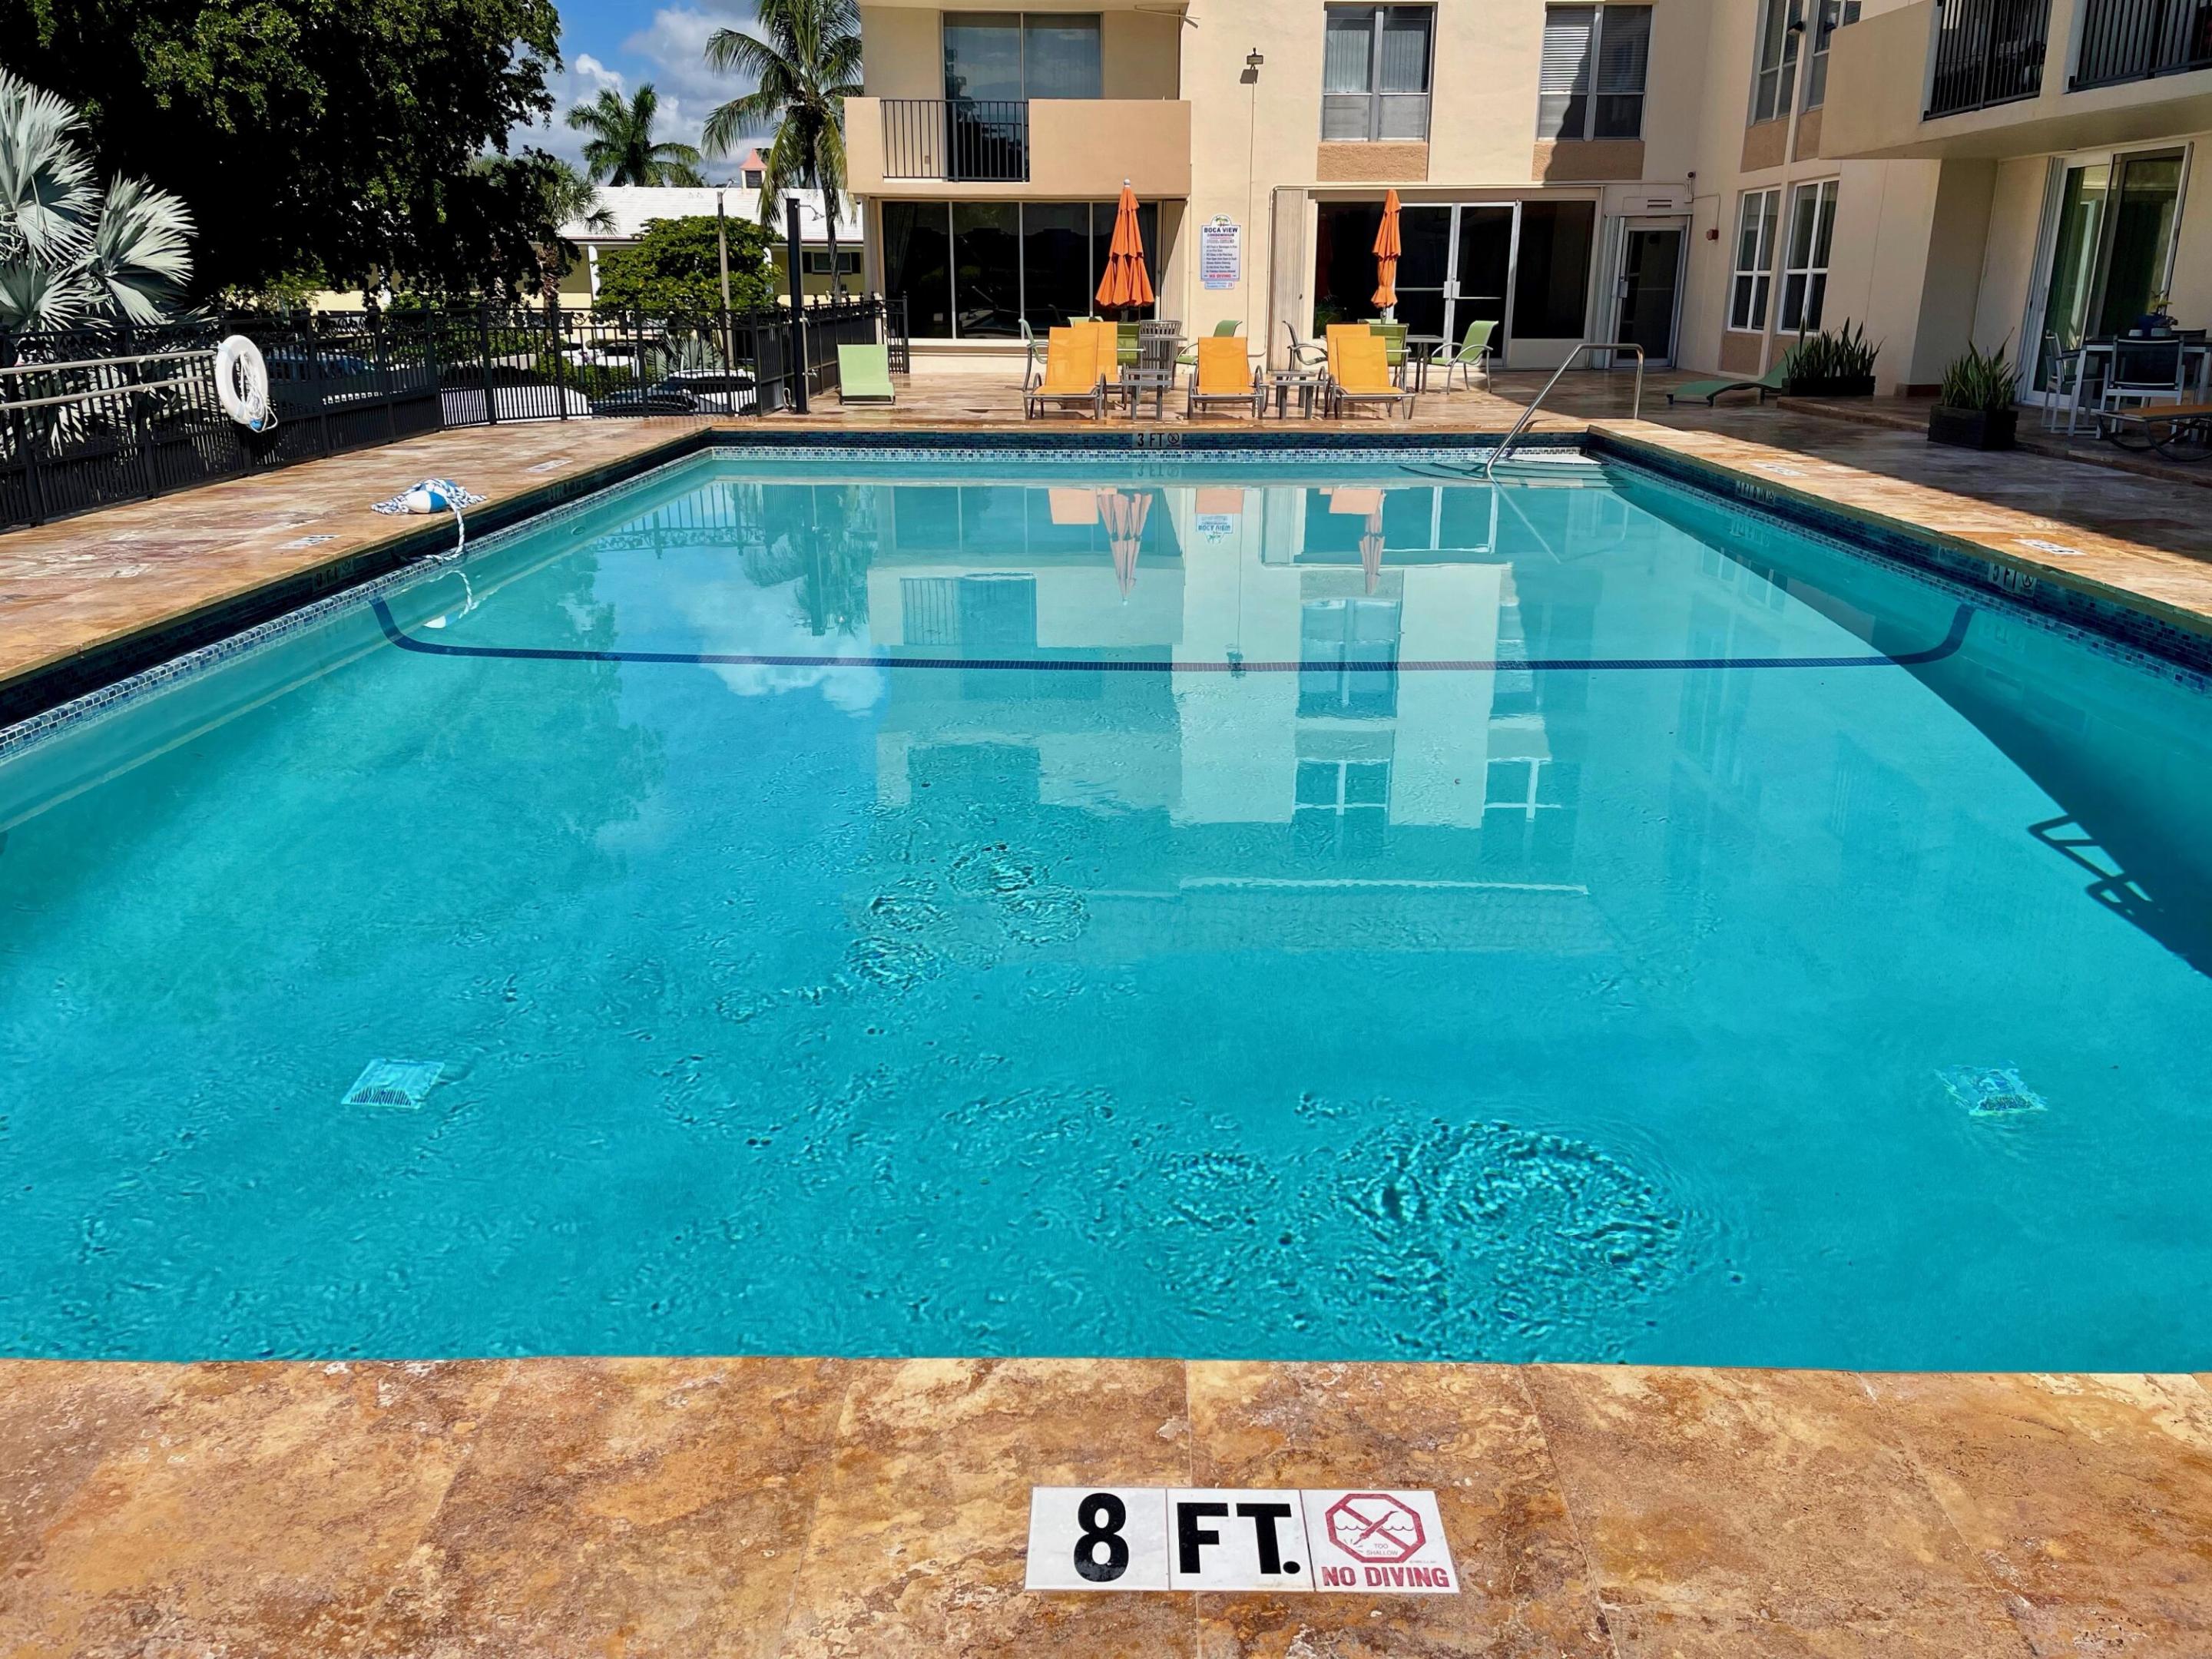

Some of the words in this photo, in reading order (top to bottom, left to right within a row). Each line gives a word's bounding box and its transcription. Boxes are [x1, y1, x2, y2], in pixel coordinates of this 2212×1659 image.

[1137, 433, 1144, 447] 3
[1150, 433, 1164, 447] FT
[1073, 1492, 1129, 1582] 8
[1177, 1502, 1301, 1575] FT.
[1322, 1566, 1357, 1587] NO
[1364, 1566, 1450, 1588] DIVING
